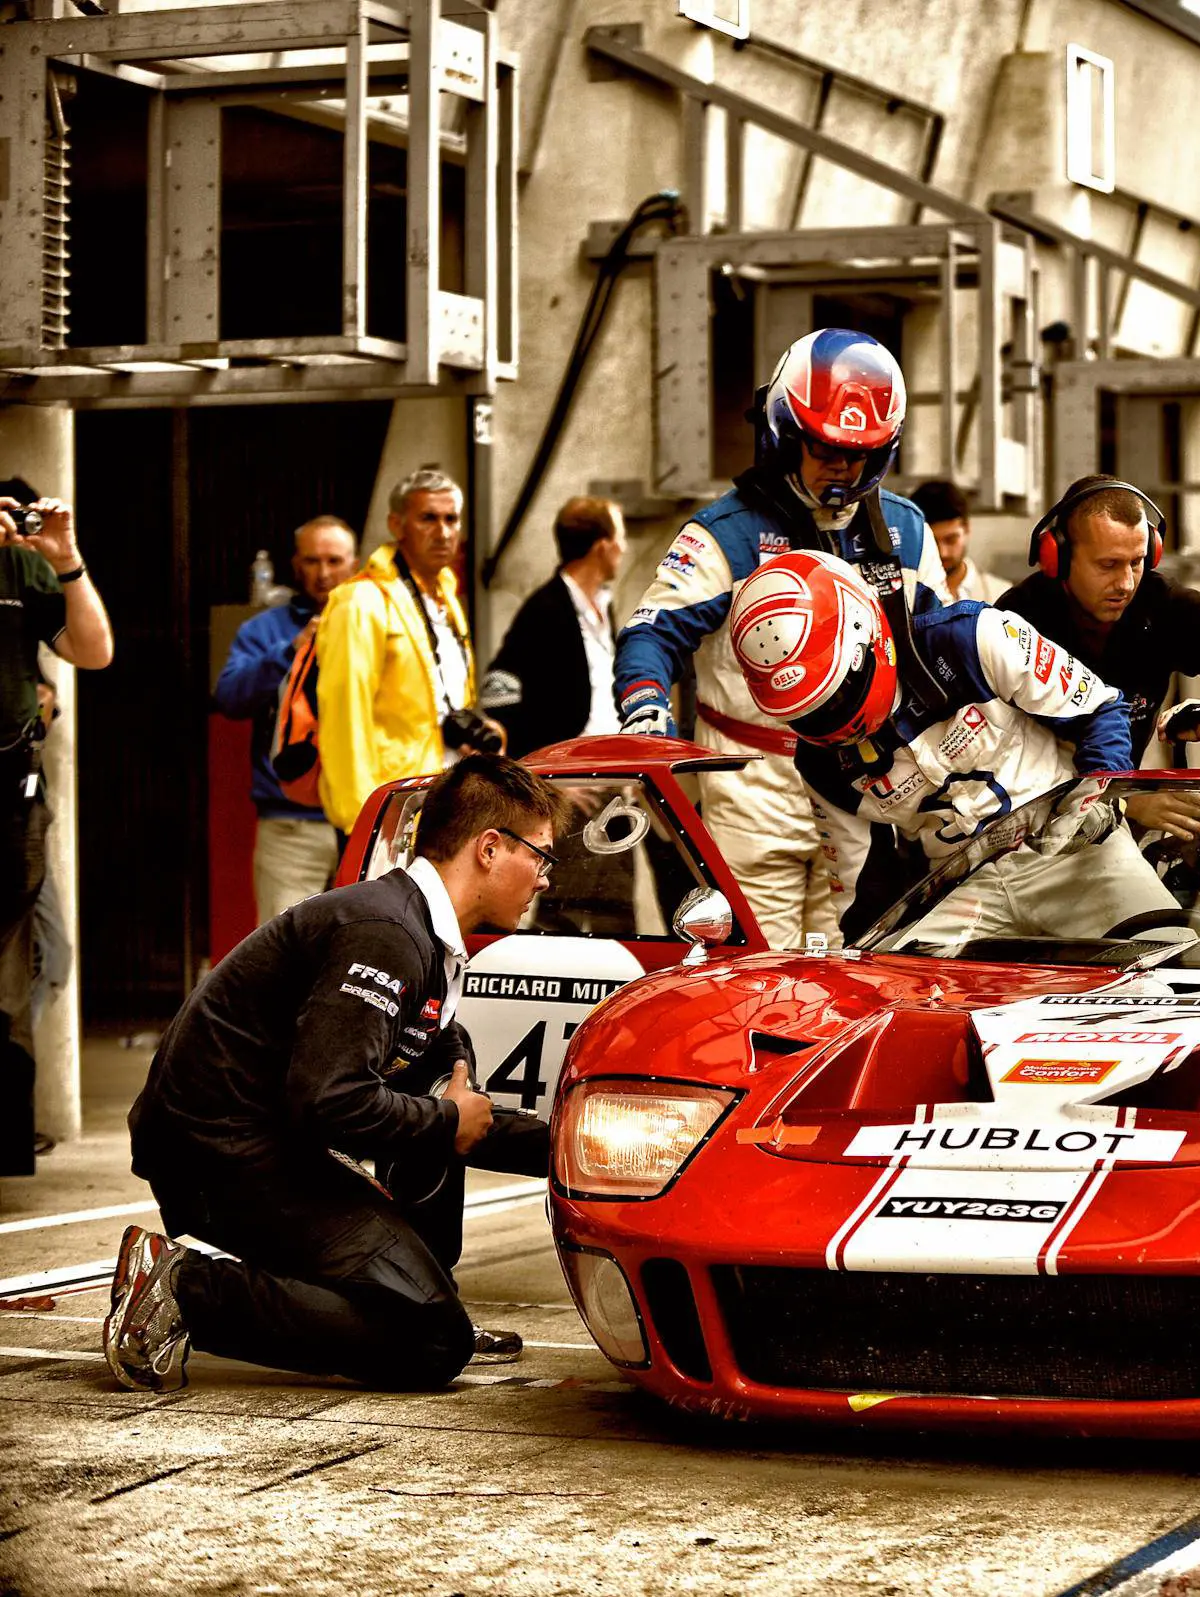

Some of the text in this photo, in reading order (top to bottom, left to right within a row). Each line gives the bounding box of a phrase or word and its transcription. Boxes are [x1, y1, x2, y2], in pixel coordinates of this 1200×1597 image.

[772, 668, 801, 687] BELL
[347, 962, 401, 995] FFSA
[466, 976, 561, 998] RICHARD
[1046, 996, 1178, 1006] RICHARD
[1026, 1032, 1171, 1044] MOTUL
[1019, 1069, 1099, 1078] Confort
[894, 1127, 1135, 1154] HUBLOT
[890, 1200, 1059, 1219] YUY263G
